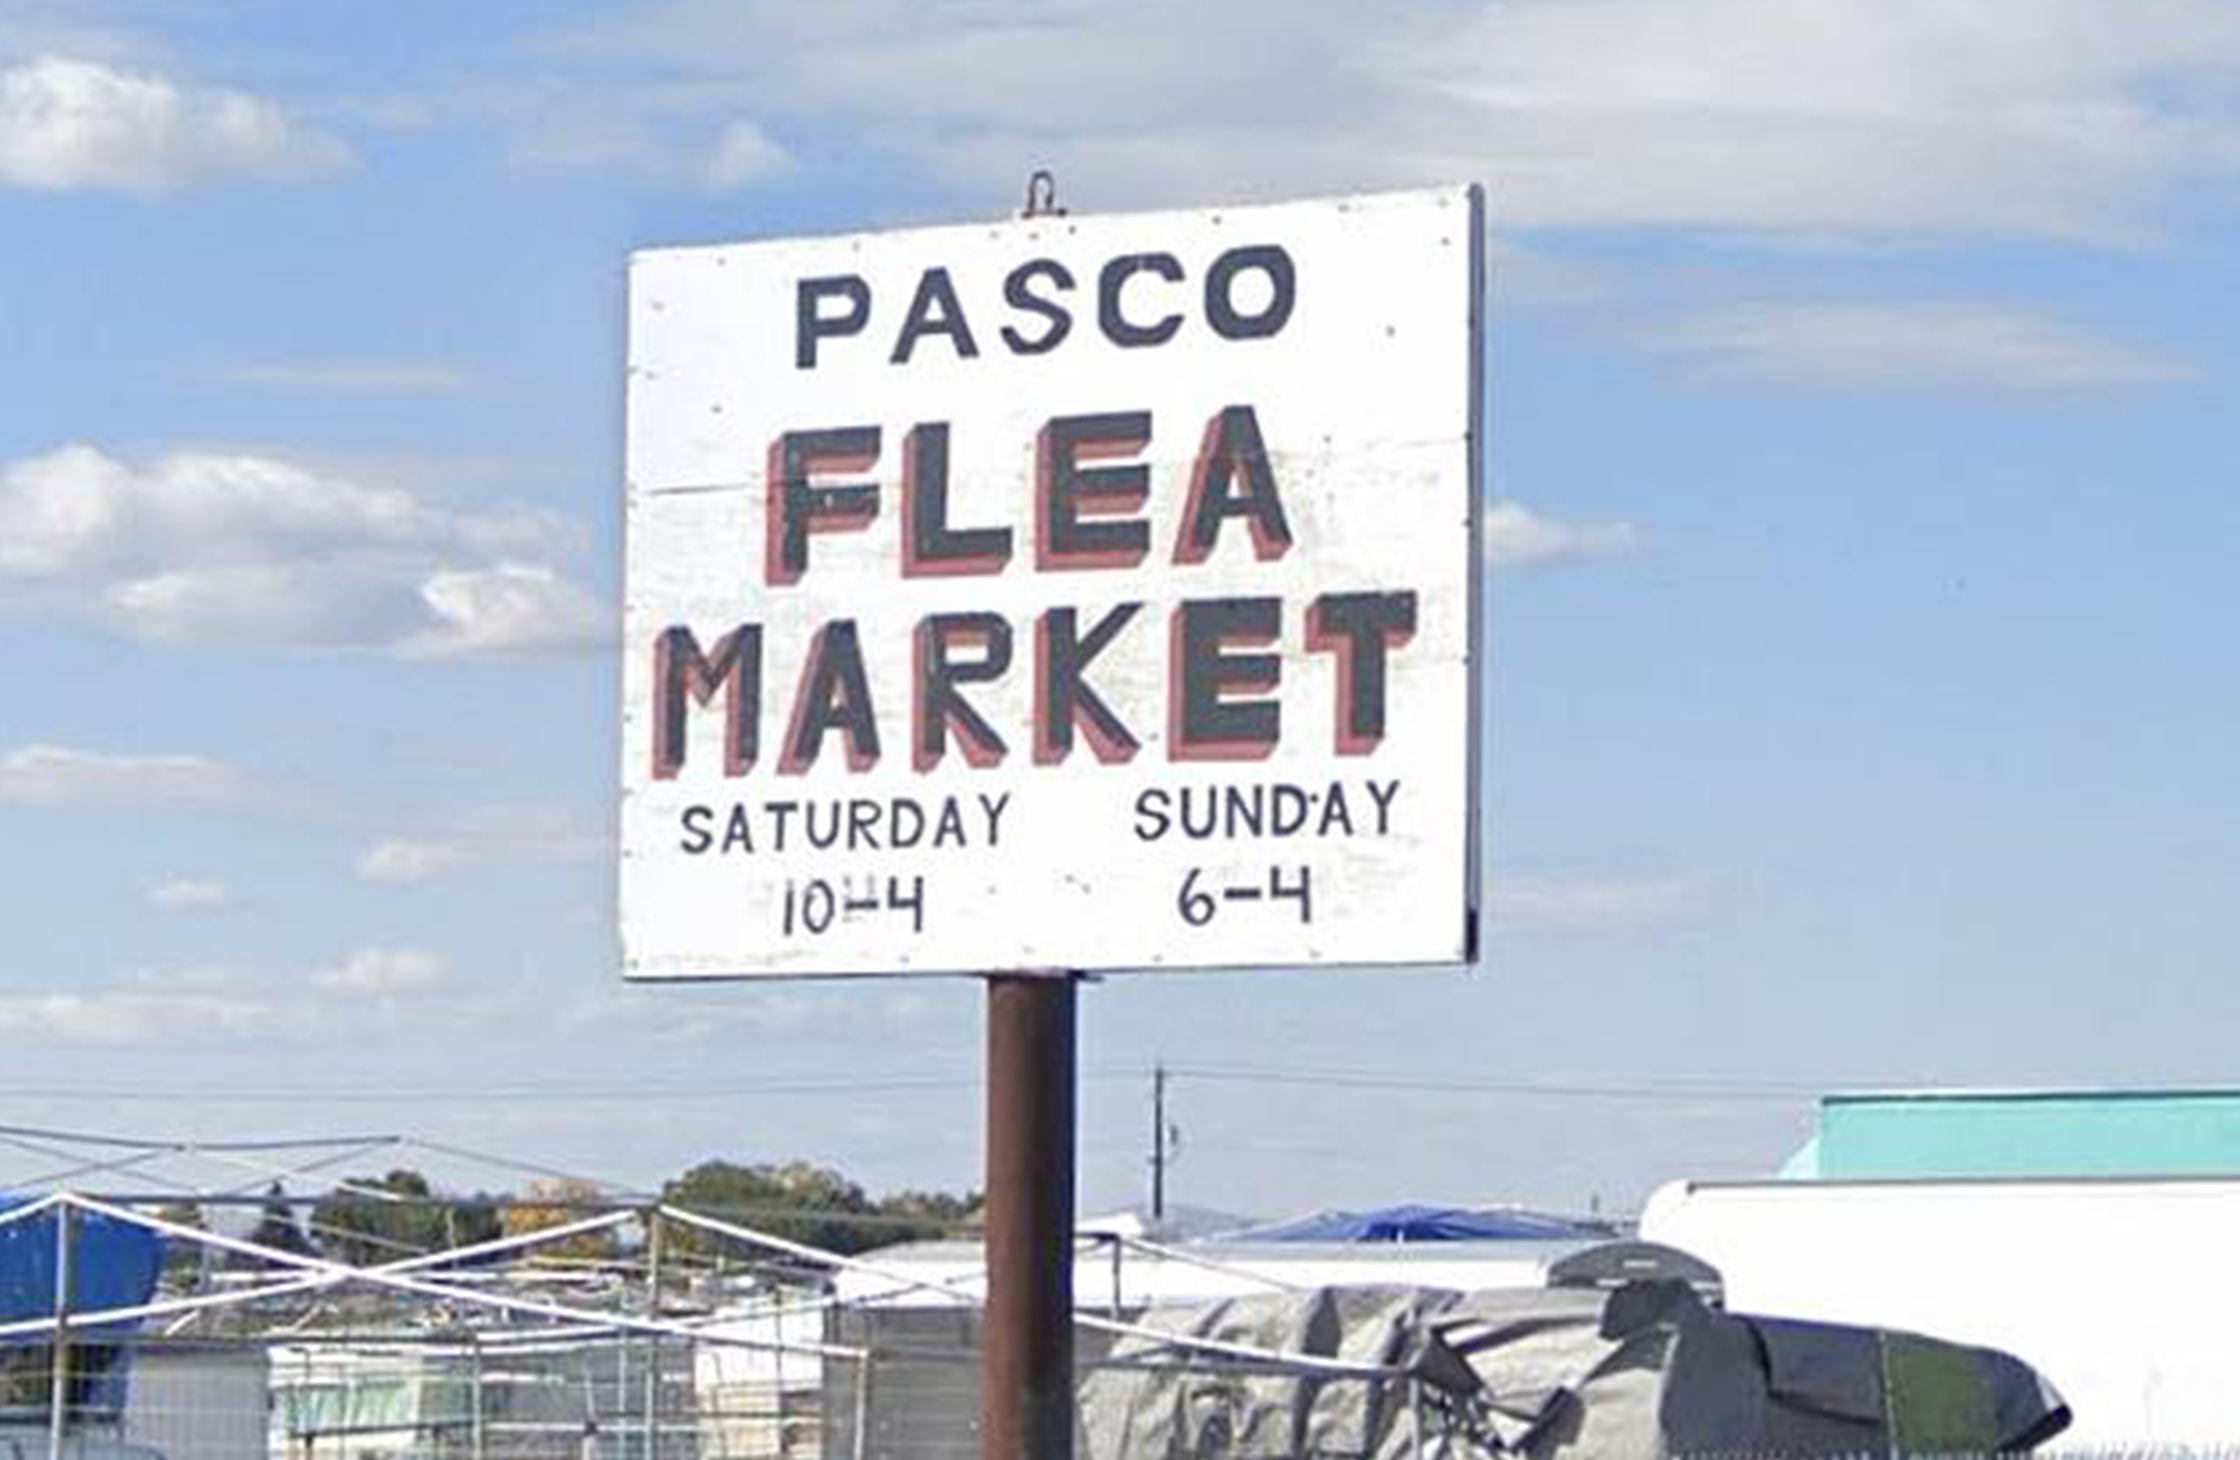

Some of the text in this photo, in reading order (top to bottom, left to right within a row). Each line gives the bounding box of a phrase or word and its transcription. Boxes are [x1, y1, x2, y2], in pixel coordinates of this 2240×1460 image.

[796, 245, 1297, 369] PASCO
[766, 405, 1293, 586] FLEA
[652, 590, 1418, 779] MARKET
[680, 792, 1010, 854] SATURDAY
[1134, 779, 1400, 841] SUNDAY
[1178, 866, 1312, 926] 6-4
